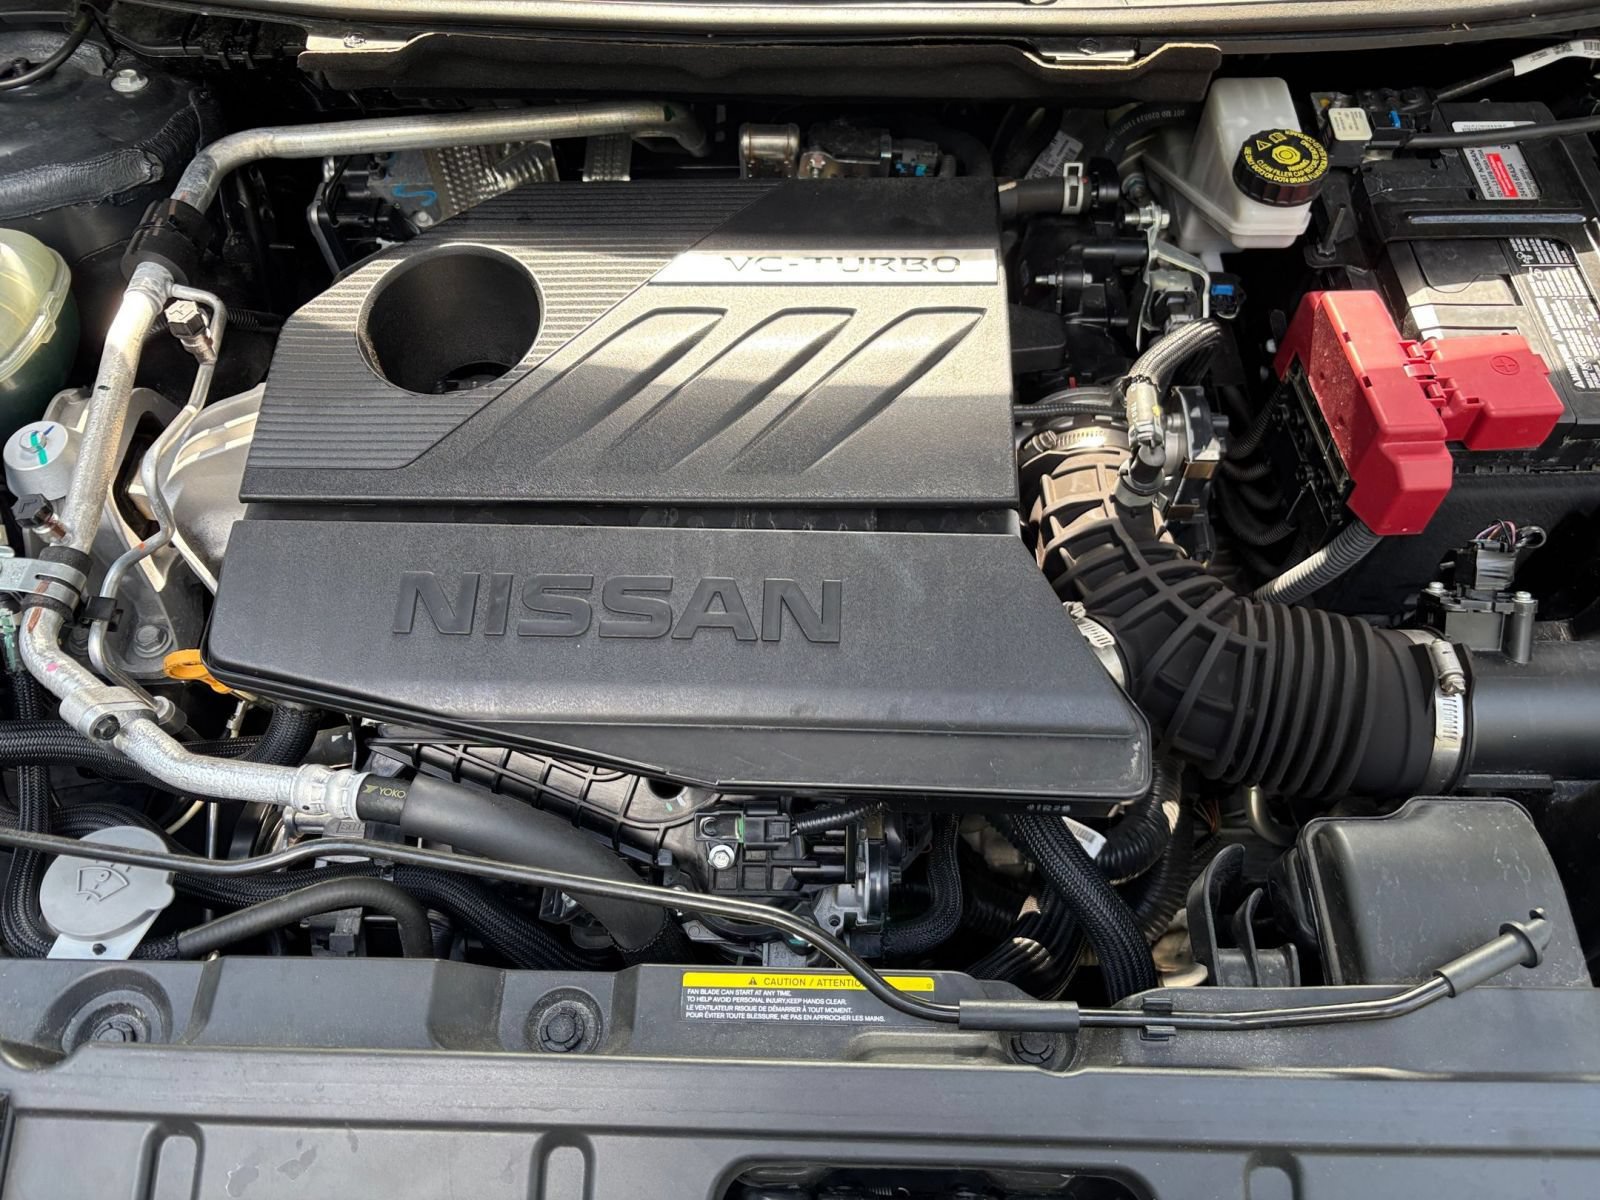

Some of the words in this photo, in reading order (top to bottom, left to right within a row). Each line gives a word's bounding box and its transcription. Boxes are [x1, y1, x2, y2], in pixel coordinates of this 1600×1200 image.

[1469, 149, 1485, 173] NISSAN
[724, 256, 961, 273] VC-TURBO
[392, 570, 842, 643] NISSAN
[763, 977, 806, 986] CAUTION
[816, 979, 862, 987] ATTENTIO
[694, 1004, 733, 1012] VENTILATEUR
[767, 1004, 801, 1012] DÉMARRER
[704, 1011, 725, 1019] ÉVITER
